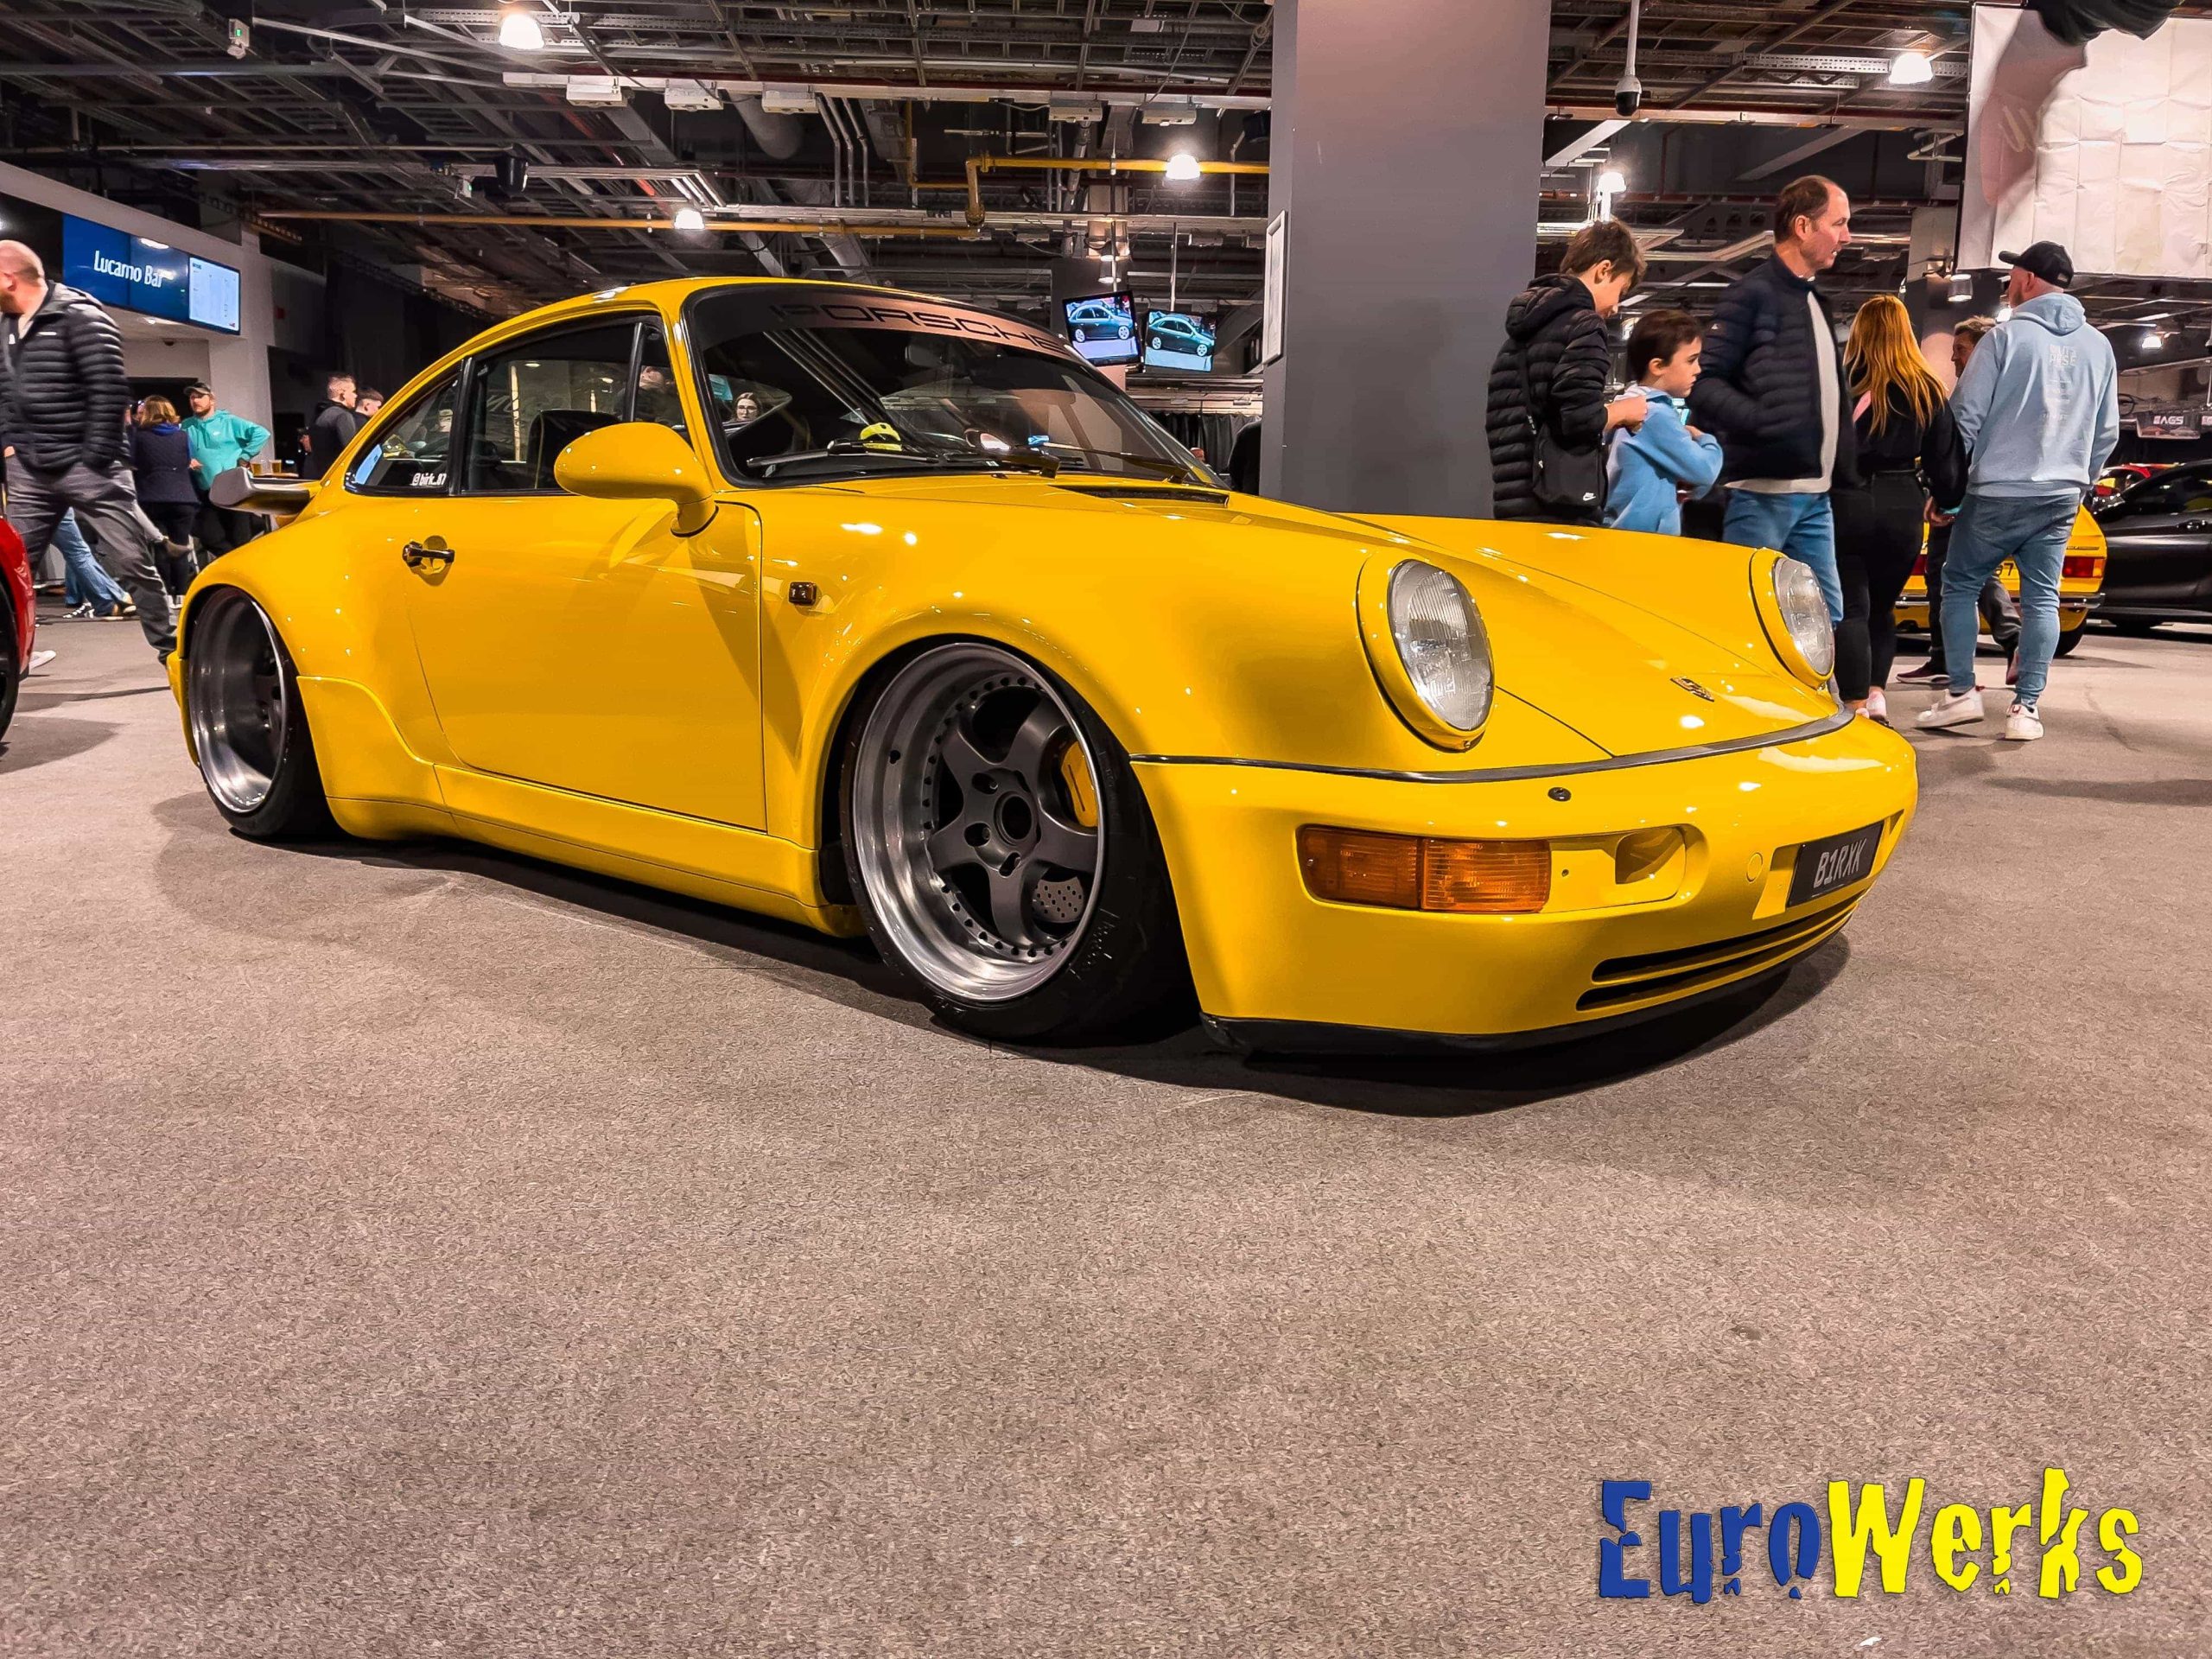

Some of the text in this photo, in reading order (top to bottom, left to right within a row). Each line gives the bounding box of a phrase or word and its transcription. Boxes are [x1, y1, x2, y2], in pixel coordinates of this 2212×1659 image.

[143, 264, 163, 289] Bar
[768, 303, 1072, 359] PORSCHE
[1813, 837, 1867, 889] B1RXK
